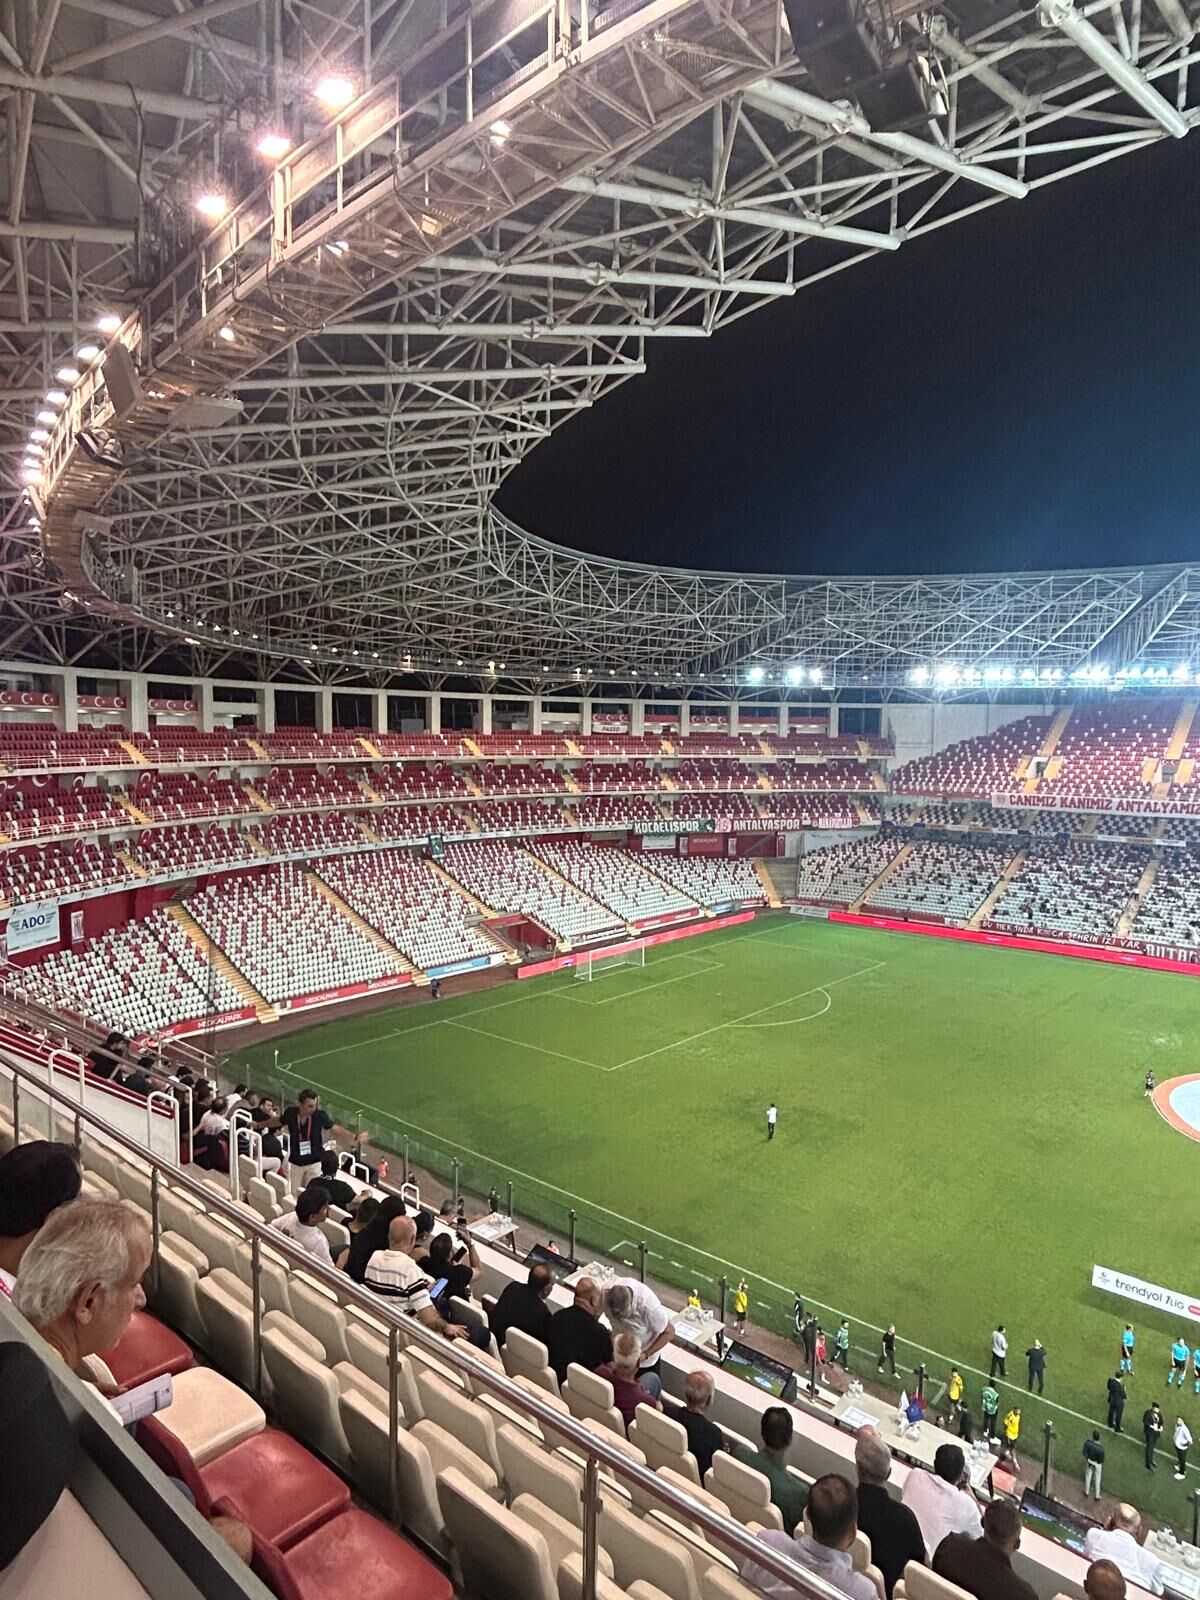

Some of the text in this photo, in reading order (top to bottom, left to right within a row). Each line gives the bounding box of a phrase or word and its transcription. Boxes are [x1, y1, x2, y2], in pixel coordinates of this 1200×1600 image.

[1060, 797, 1112, 811] KANIMIZ
[733, 818, 800, 831] ANTALYASPOR
[21, 915, 45, 929] ADO
[1120, 940, 1141, 949] VAR
[1115, 1278, 1163, 1302] trendyol
